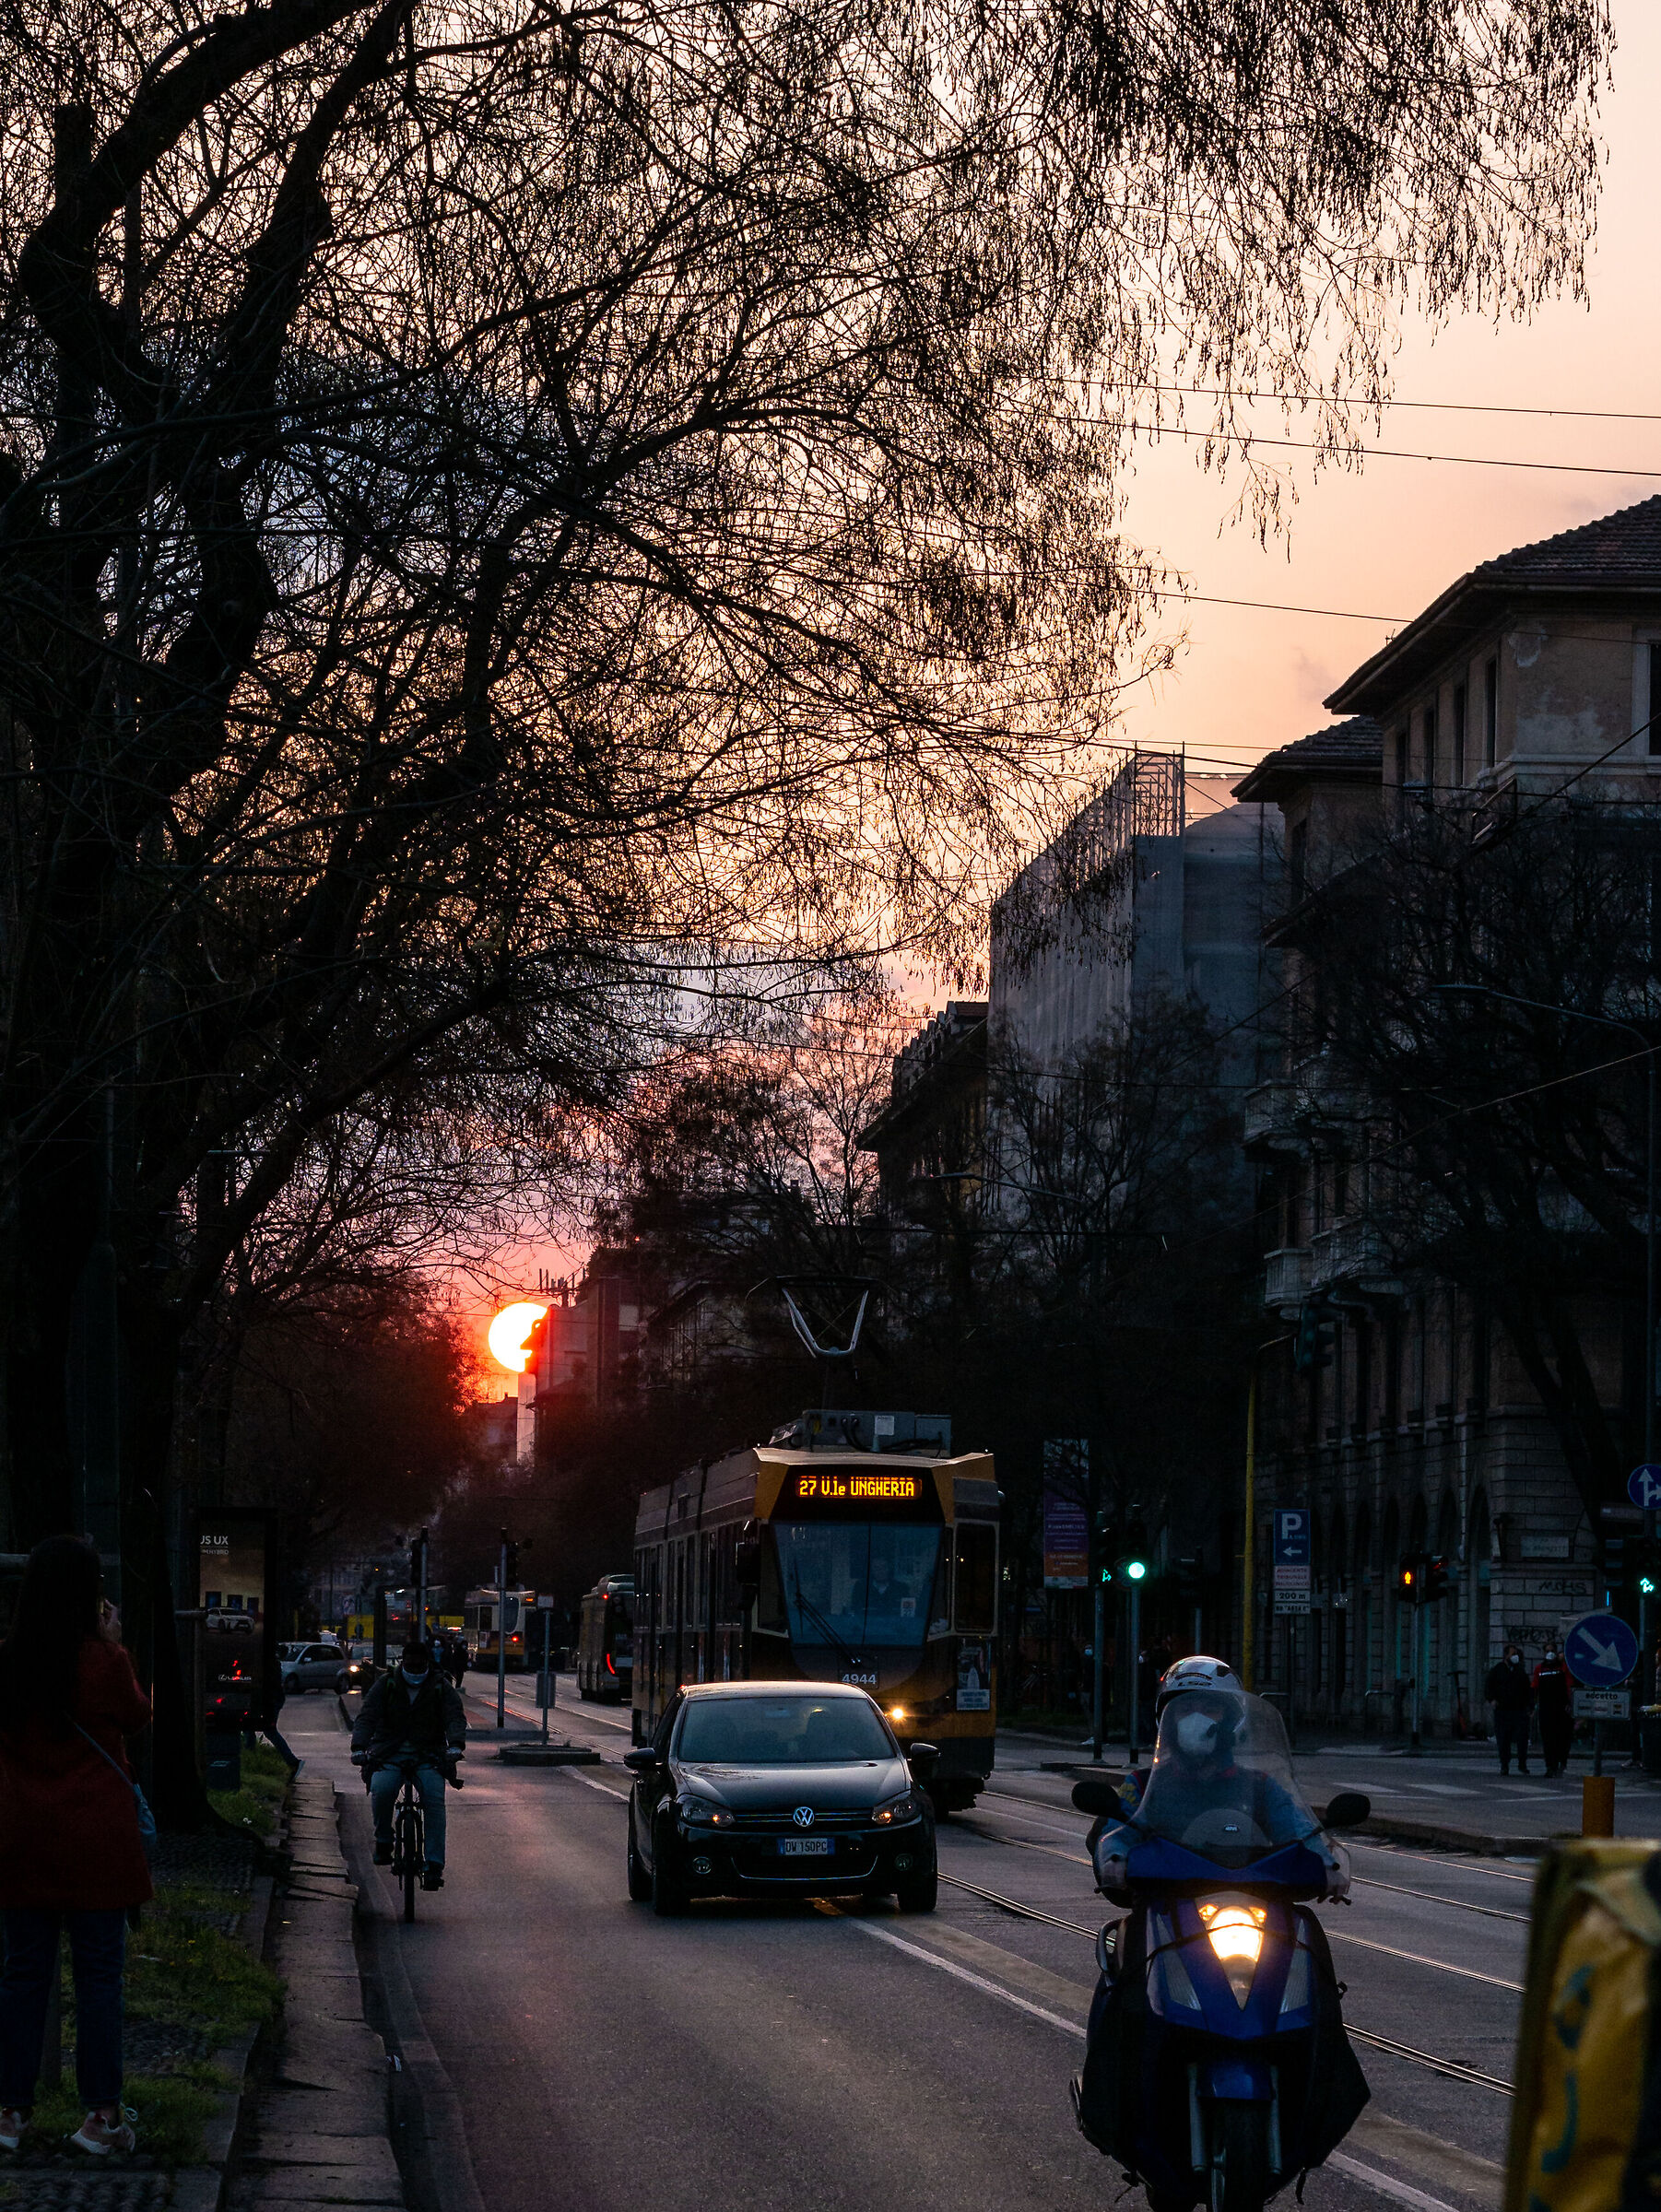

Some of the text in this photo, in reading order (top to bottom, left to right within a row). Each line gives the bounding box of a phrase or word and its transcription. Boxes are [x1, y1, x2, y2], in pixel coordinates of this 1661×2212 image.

[799, 1477, 817, 1496] 27
[850, 1478, 914, 1497] UNGHERIA
[1281, 1512, 1302, 1539] P
[214, 1535, 229, 1545] UX
[1278, 1592, 1297, 1600] 200
[841, 1673, 878, 1685] 4944
